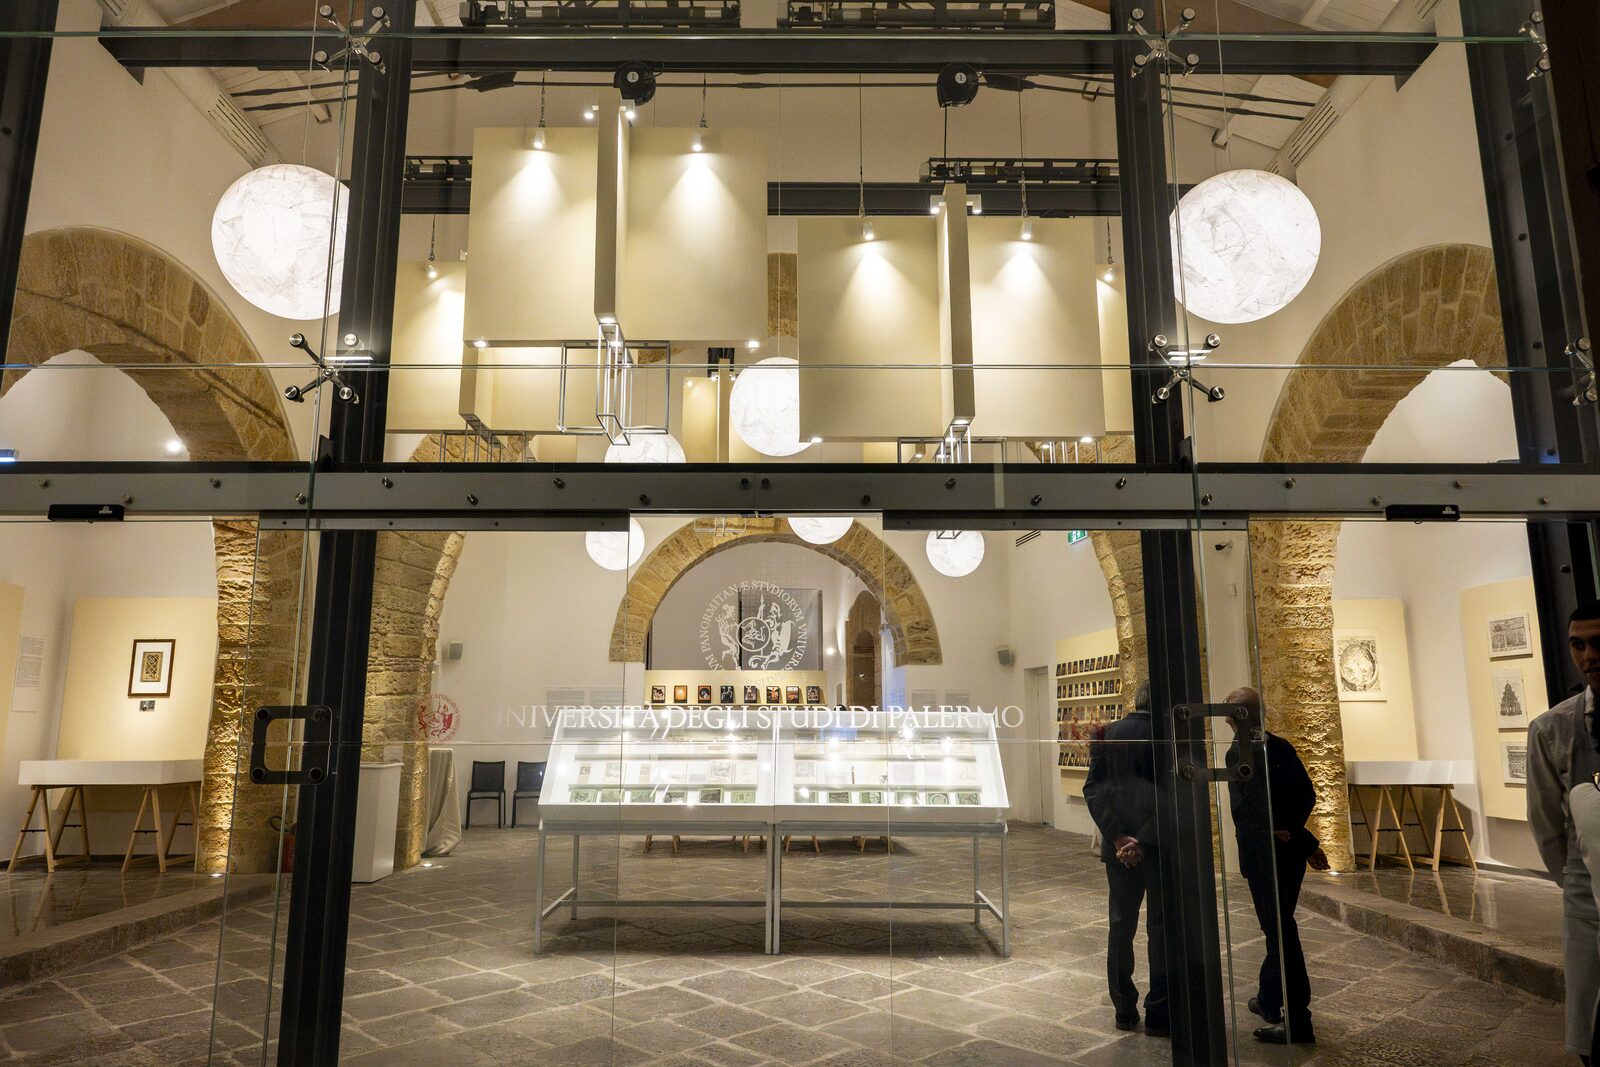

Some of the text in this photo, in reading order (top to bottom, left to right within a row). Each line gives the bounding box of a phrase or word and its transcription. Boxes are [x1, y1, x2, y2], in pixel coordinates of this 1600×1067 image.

[751, 580, 805, 622] STVDIORVM
[665, 705, 749, 729] DEGLI
[756, 705, 844, 729] STUDI
[849, 705, 880, 729] DI
[887, 705, 1025, 729] PALERMO
